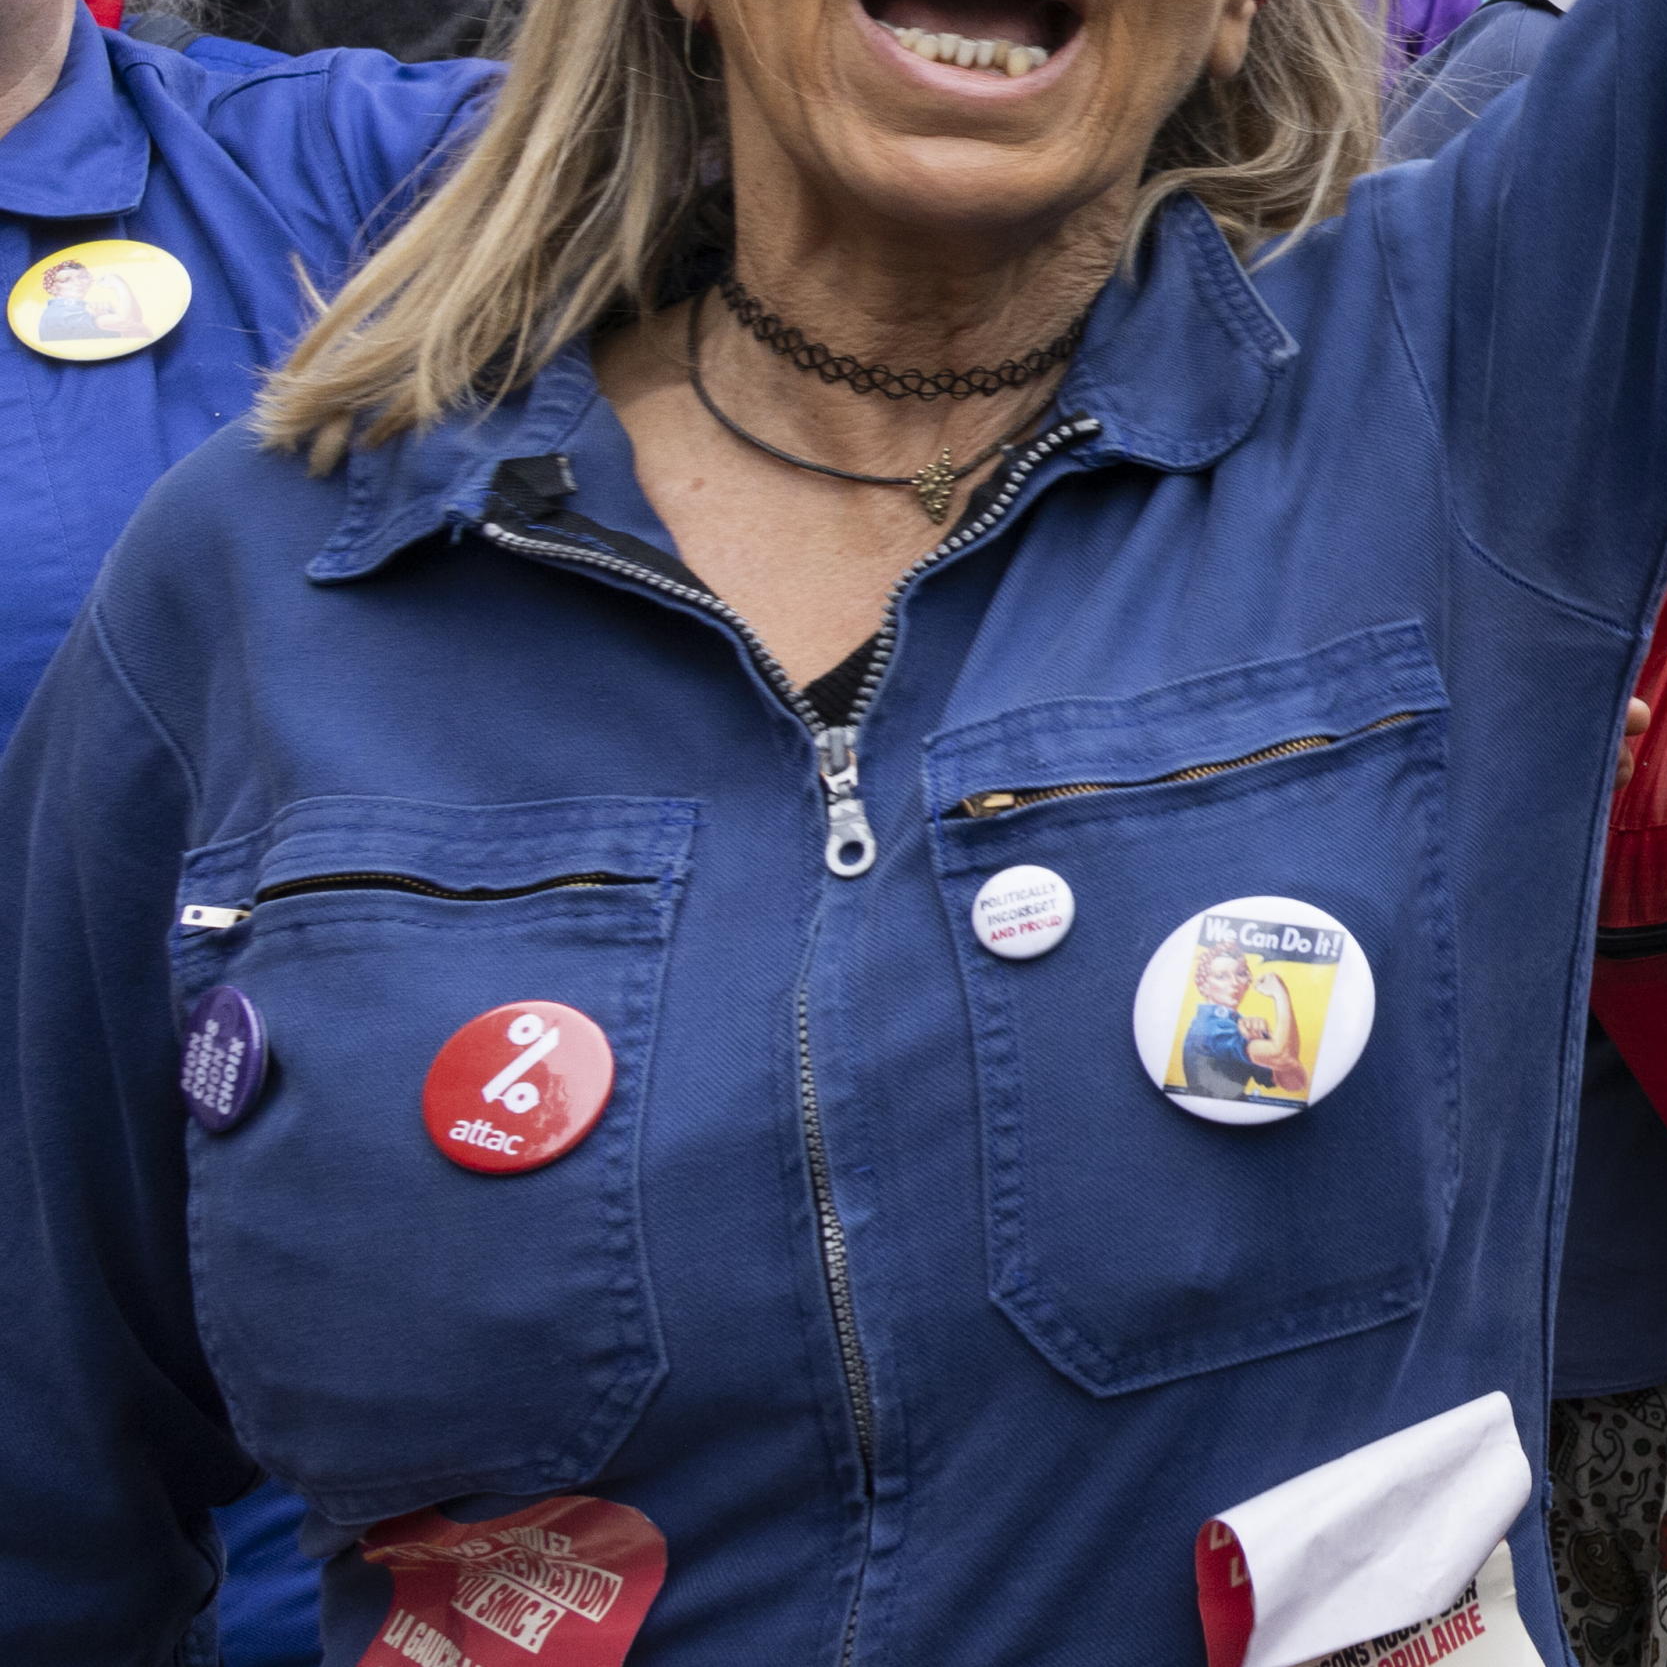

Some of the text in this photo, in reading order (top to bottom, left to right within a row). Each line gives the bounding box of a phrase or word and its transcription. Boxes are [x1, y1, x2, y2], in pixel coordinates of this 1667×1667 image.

[980, 882, 1057, 911] POLITICALLY
[987, 898, 1057, 927] INCORRECT
[991, 915, 1063, 943] AND PROUD
[1205, 917, 1342, 958] We Can Do It!
[180, 1031, 202, 1093] MON
[203, 1047, 227, 1109] MON
[216, 1036, 246, 1116] CHOIX
[448, 1118, 525, 1157] attac
[382, 1608, 416, 1650] LA
[475, 1580, 543, 1639] SMIC
[1376, 1602, 1487, 1667] OPULAIRE
